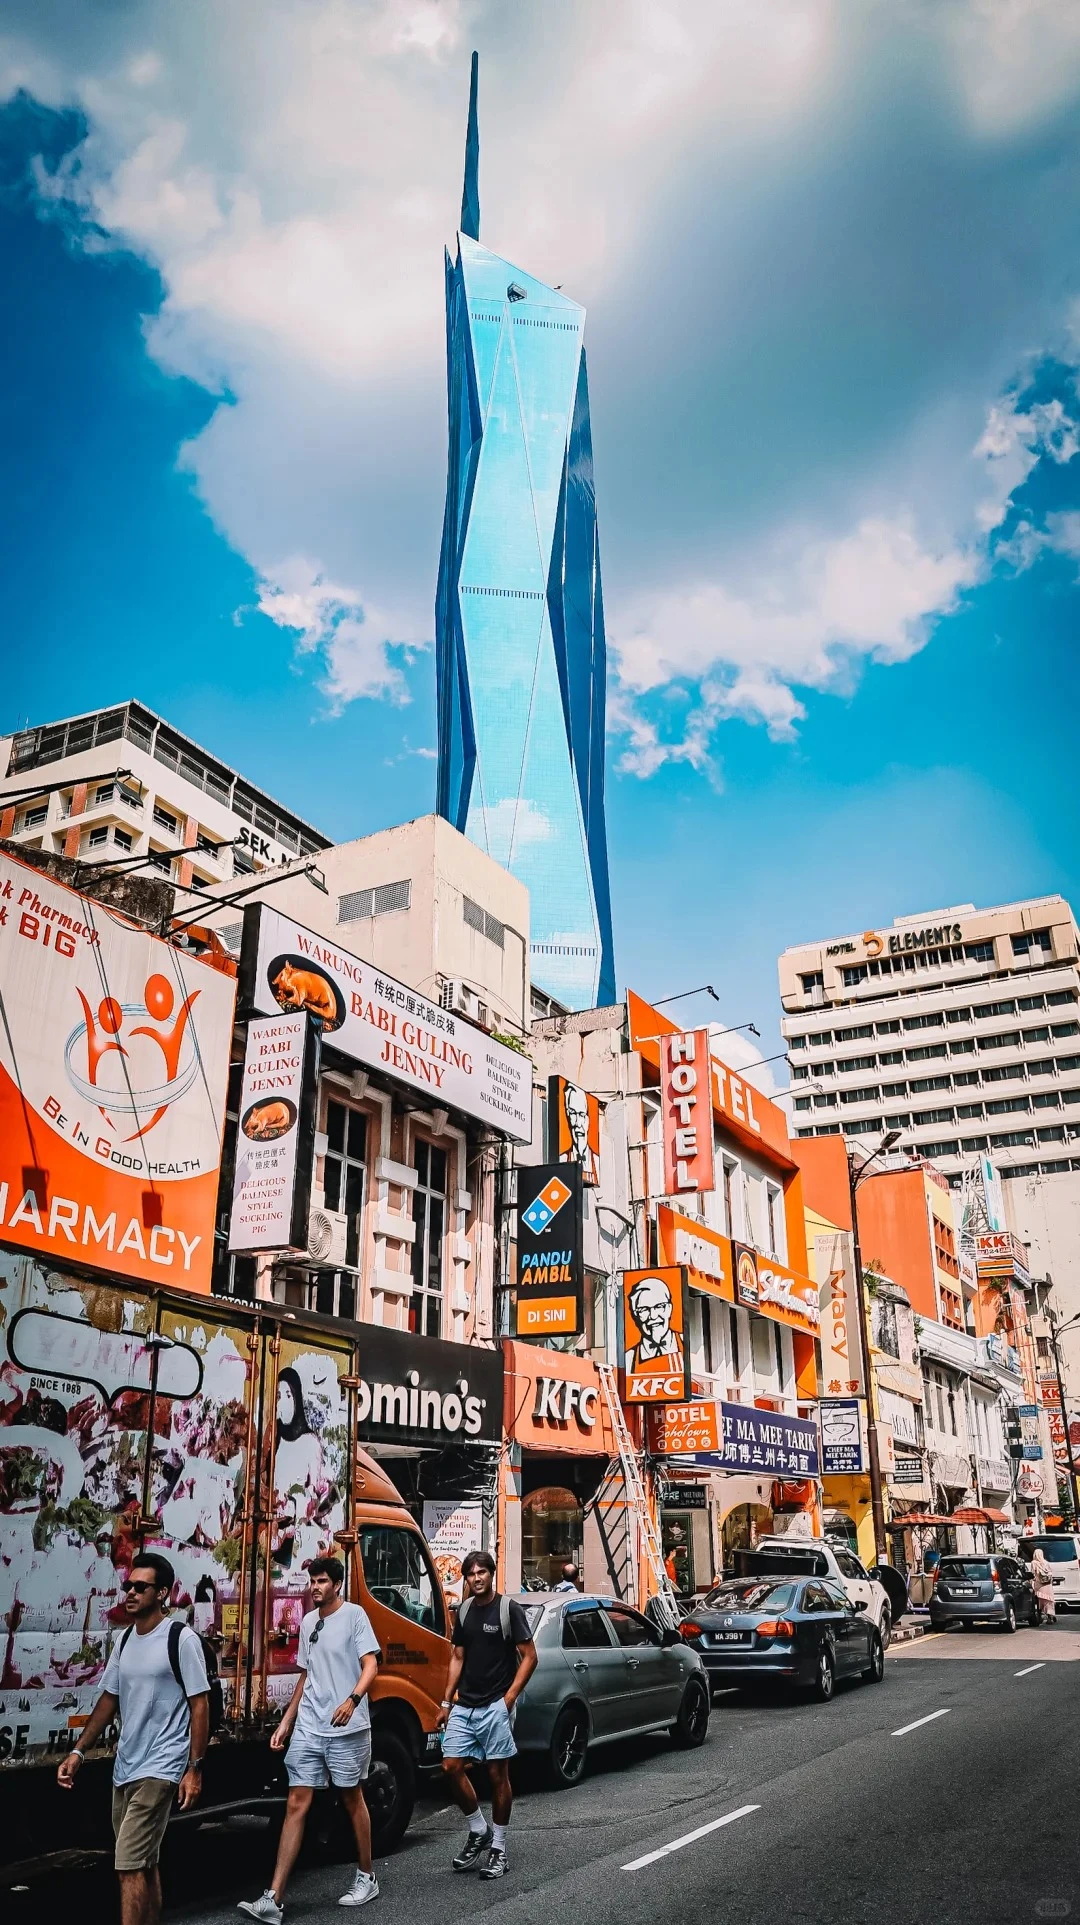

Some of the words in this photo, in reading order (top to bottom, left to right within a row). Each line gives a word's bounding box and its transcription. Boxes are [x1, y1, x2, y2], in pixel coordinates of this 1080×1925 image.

[240, 827, 275, 863] SEK.
[17, 887, 101, 947] Pharmacy,
[18, 912, 77, 958] BIG
[826, 943, 856, 957] HOTEL
[863, 930, 884, 957] 5
[888, 924, 962, 953] ELEMENTS
[297, 933, 363, 984] WARUNG
[374, 977, 455, 1036] 传统巴厘式脆皮猪
[252, 1023, 301, 1040] WARUNG
[350, 990, 396, 1037] BABI
[401, 1020, 473, 1075] GULING
[259, 1040, 292, 1056] BABI
[247, 1056, 300, 1075] GULING
[381, 1039, 445, 1088] JENNY
[485, 1053, 521, 1080] DELICIOUS
[249, 1073, 296, 1092] JENNY
[487, 1068, 519, 1093] BALINESE
[491, 1084, 513, 1102] STYLE
[479, 1091, 514, 1116] SUCKLING
[513, 1107, 526, 1122] PIG
[671, 1034, 699, 1189] HOTEL
[95, 1137, 143, 1171] GOOD
[149, 1158, 201, 1174] HEALTH
[240, 1176, 286, 1190] DELICIOUS
[241, 1188, 283, 1201] BALINESE
[247, 1201, 274, 1212] STYLE
[239, 1211, 283, 1224] SUCKLING
[252, 1225, 267, 1234] PIG
[980, 1235, 1007, 1249] KK
[521, 1250, 572, 1269] PANDU
[521, 1264, 572, 1285] AMBIL
[527, 1311, 540, 1323] DI
[543, 1309, 566, 1322] SINI
[830, 1269, 849, 1360] Macy
[30, 1377, 59, 1391] SINCE
[629, 1376, 682, 1397] KFC
[1041, 1388, 1061, 1399] KK
[537, 1376, 600, 1427] KFC
[653, 1406, 711, 1423] HOTEL
[1047, 1415, 1064, 1427] 24
[656, 1422, 711, 1440] SohoTown
[736, 1419, 756, 1442] MA
[759, 1423, 784, 1446] MEE
[785, 1429, 816, 1452] TARIK
[428, 1521, 447, 1529] Babi
[449, 1521, 477, 1530] Guling
[436, 1513, 470, 1522] Warung
[439, 1530, 464, 1538] Jenny
